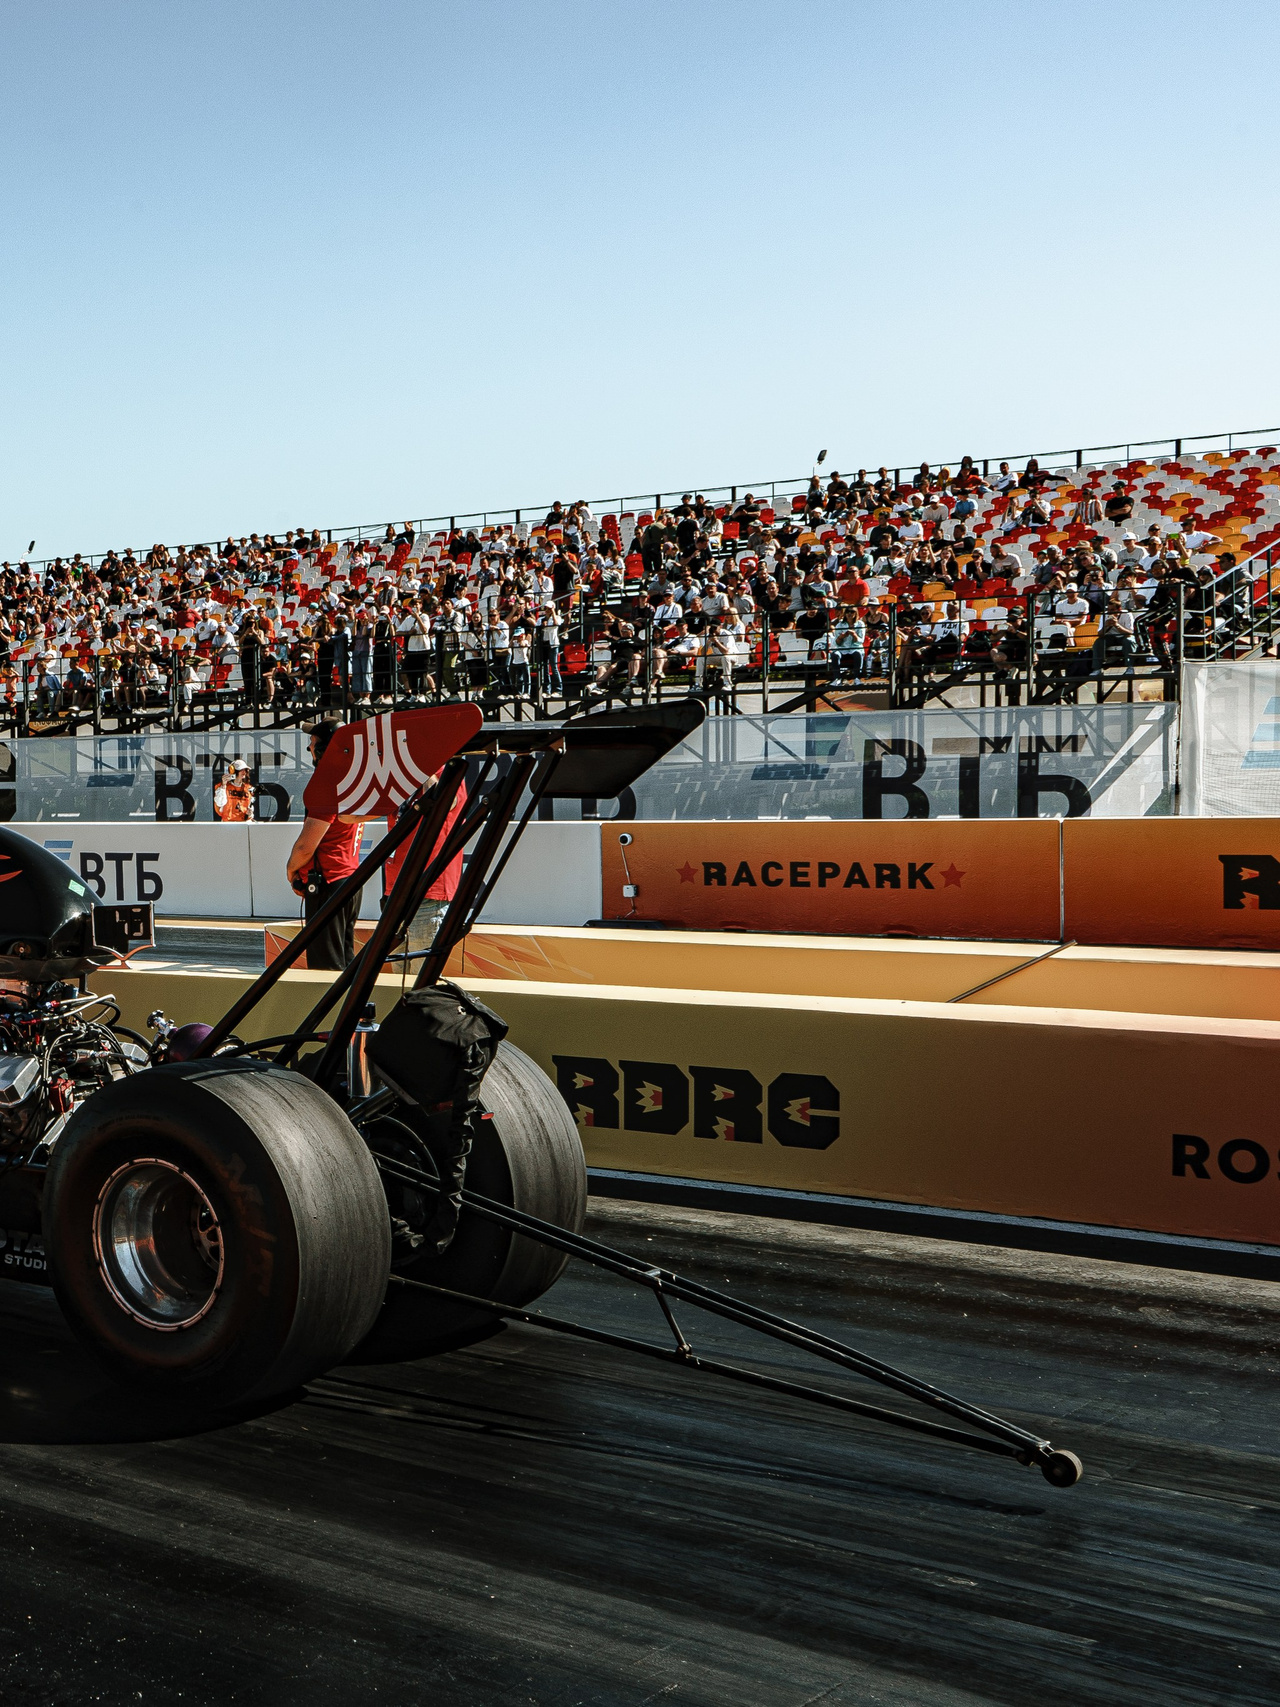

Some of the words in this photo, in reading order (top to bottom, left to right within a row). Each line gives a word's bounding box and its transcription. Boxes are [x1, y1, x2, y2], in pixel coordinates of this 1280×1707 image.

[862, 735, 1092, 819] ВТБ
[80, 852, 163, 901] ВТБ
[701, 861, 935, 889] RACEPARK
[552, 1055, 840, 1151] RDRC
[1172, 1134, 1280, 1184] RO
[4, 1254, 47, 1270] STUDI
